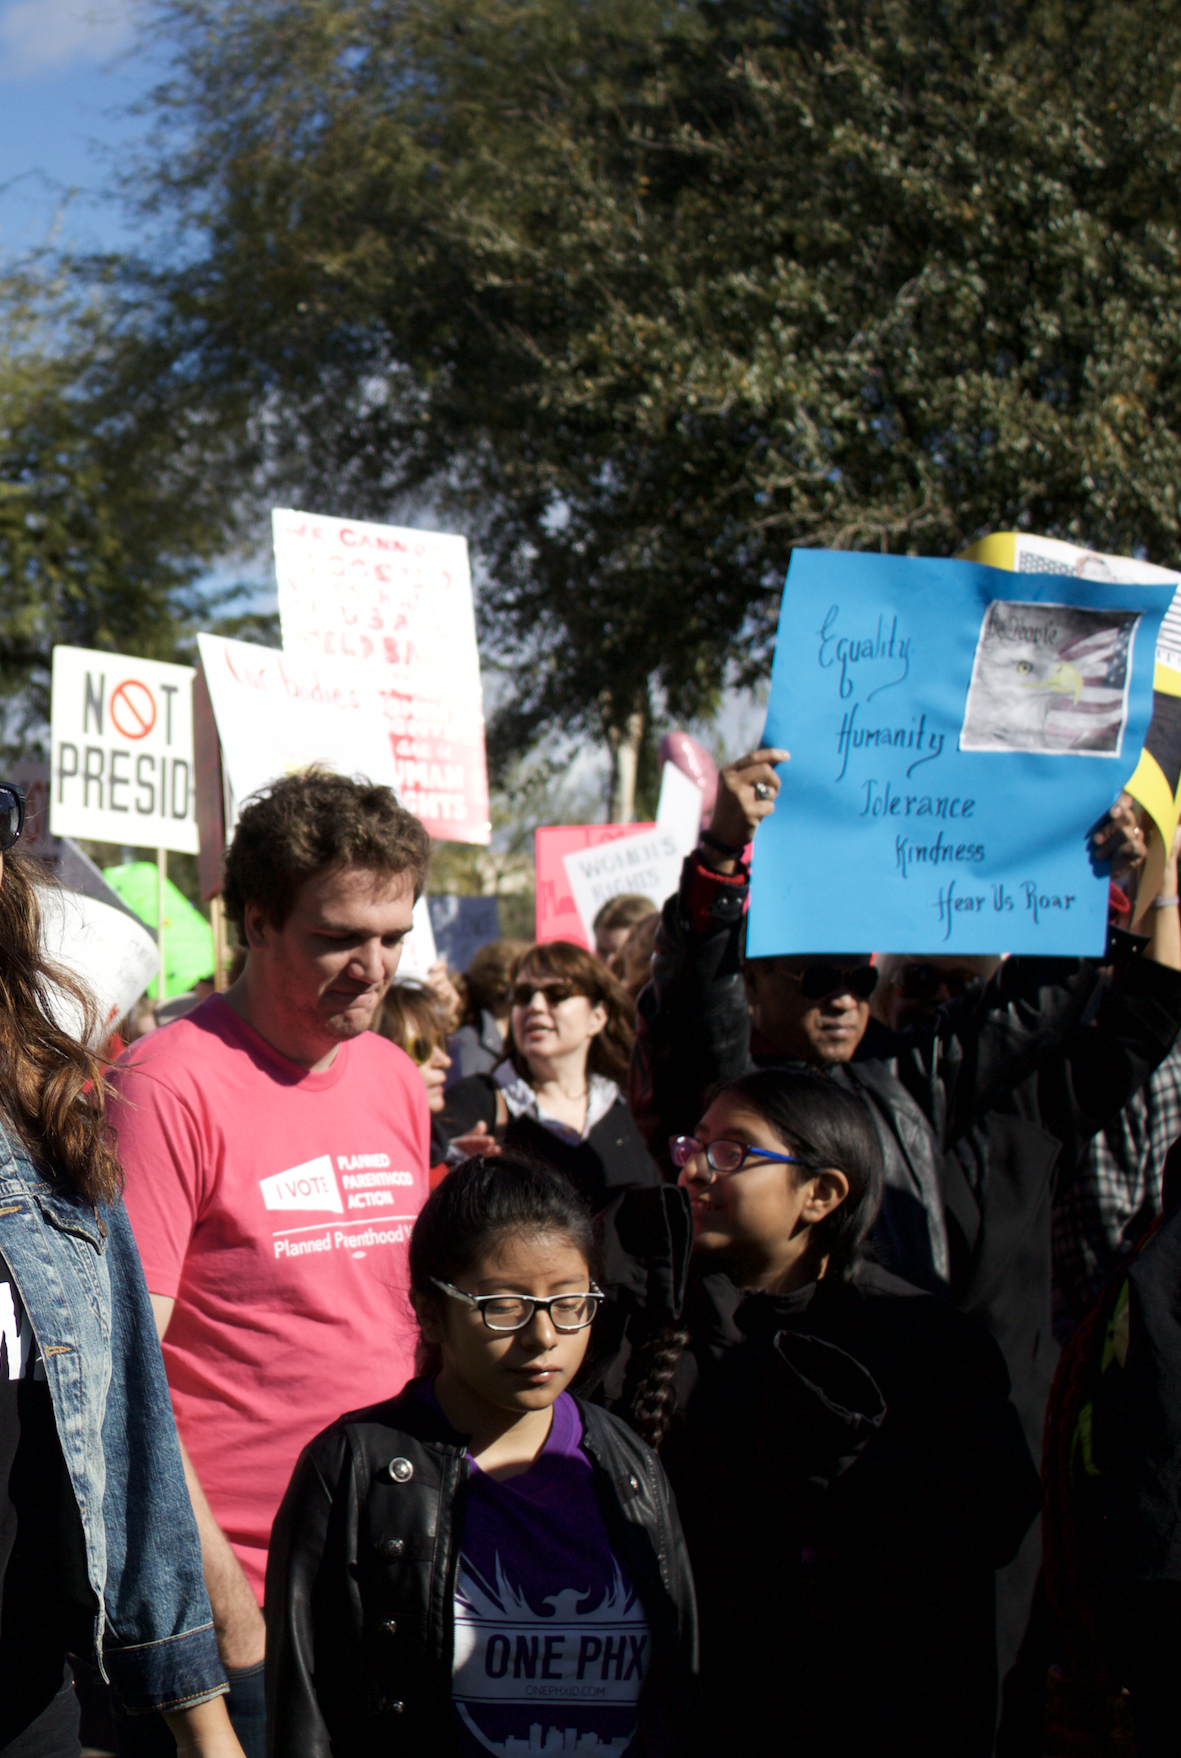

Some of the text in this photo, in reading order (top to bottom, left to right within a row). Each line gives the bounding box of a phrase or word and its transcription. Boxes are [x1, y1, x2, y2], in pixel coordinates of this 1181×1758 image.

[336, 525, 443, 558] CANNO
[295, 624, 375, 660] ELD
[817, 603, 912, 702] Equality
[276, 655, 360, 709] bodies
[834, 702, 946, 783] Humanity
[859, 778, 976, 819] Tolerance
[894, 830, 985, 879] Kindness
[933, 880, 1077, 941] Hear Us Roar
[336, 1152, 391, 1171] PLANNED
[341, 1171, 414, 1190] PARENTHOOD
[275, 1176, 330, 1200] I VOTE
[347, 1190, 395, 1209] ACTION
[273, 1231, 332, 1259] Planned
[484, 1633, 649, 1681] ONE PHX
